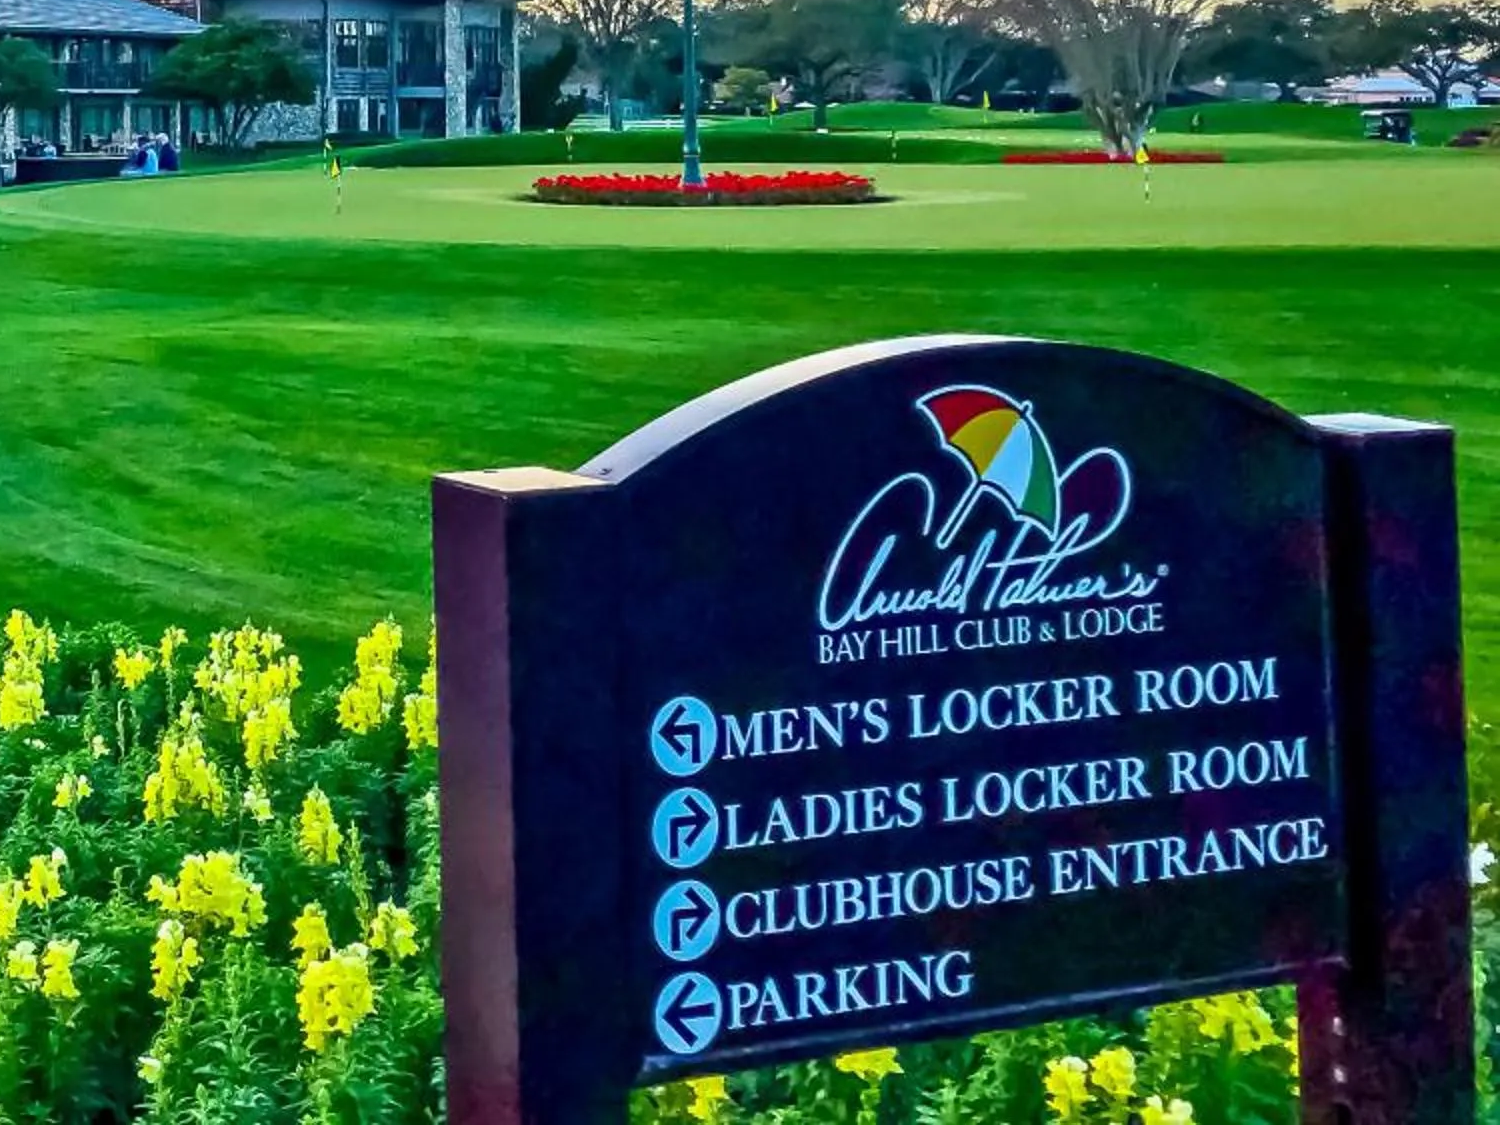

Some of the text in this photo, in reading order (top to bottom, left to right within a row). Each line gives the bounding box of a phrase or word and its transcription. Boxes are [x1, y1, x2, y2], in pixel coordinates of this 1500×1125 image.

[818, 602, 1166, 664] BAY HILL CLUB & LODGE
[720, 657, 1280, 761] MEN'S LOCKER ROOM
[723, 736, 1310, 851] LADIES LOCKER ROOM
[724, 817, 1330, 940] CLUBHOUSE ENTRANCE
[725, 949, 975, 1031] PARKING
